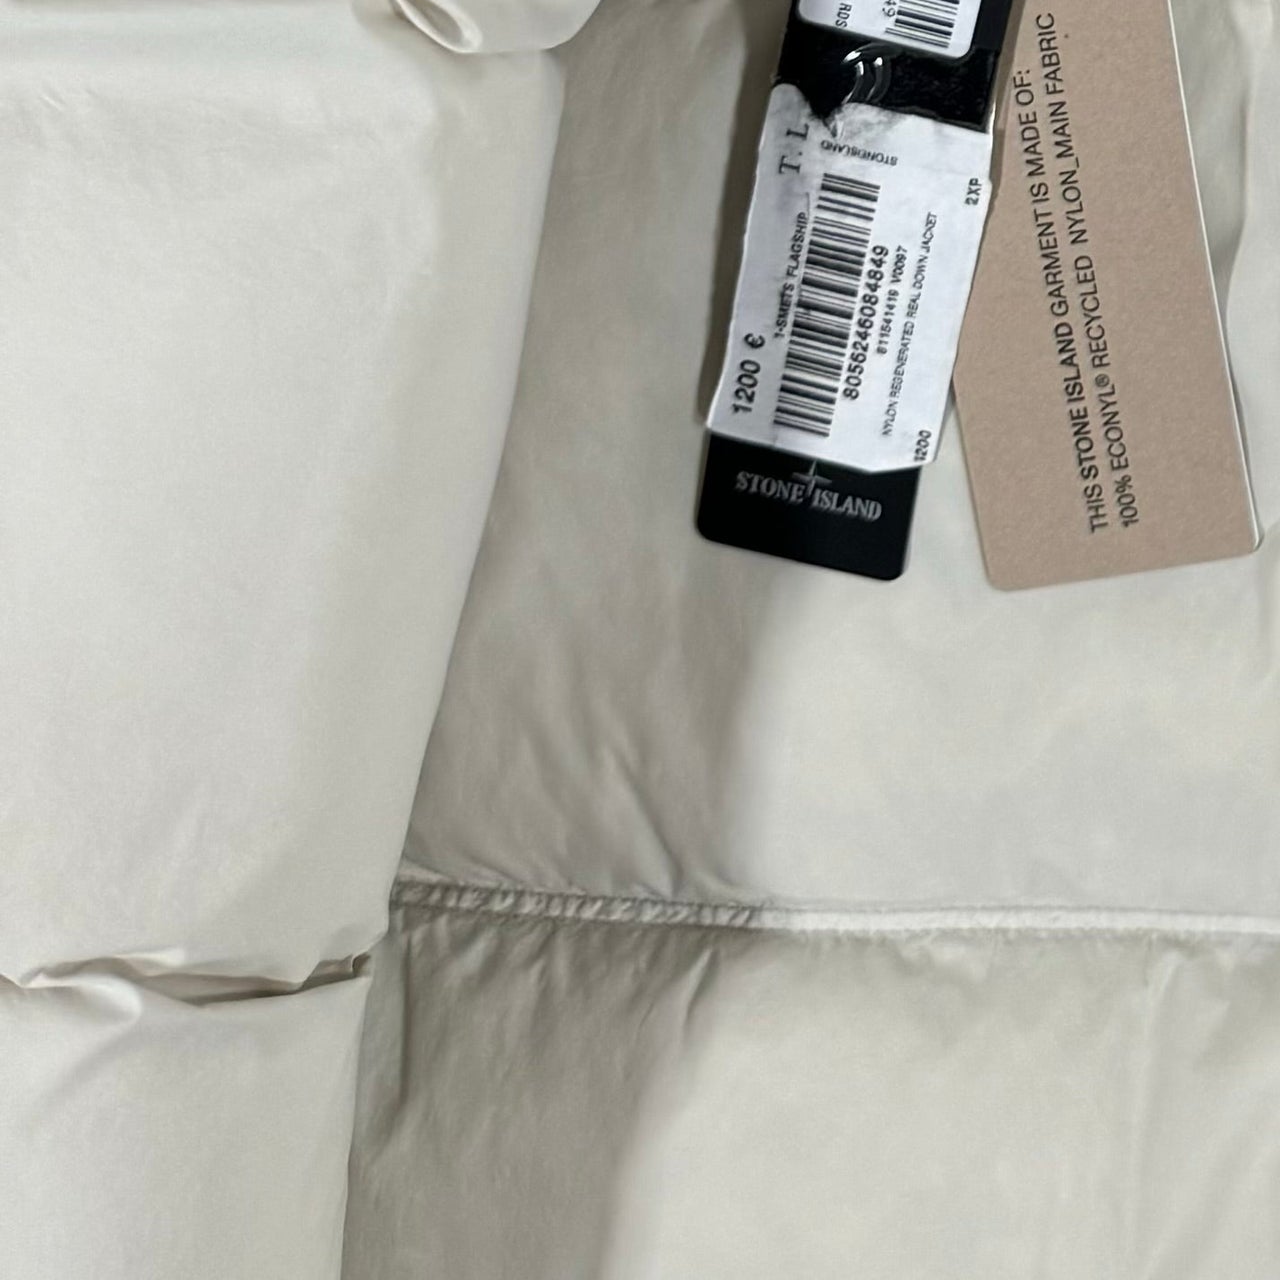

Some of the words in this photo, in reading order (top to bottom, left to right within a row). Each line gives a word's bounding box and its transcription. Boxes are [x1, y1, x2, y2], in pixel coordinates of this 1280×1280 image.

[835, 2, 852, 28] RDS
[1036, 12, 1064, 95] FABRIC
[1013, 68, 1035, 108] OF:
[1018, 111, 1046, 177] MADE
[1030, 182, 1051, 205] IS
[1047, 100, 1089, 245] NYLON_MAIN
[787, 212, 808, 278] FLAGSHIP
[920, 211, 937, 252] JACKET
[913, 250, 929, 290] DOWN
[1034, 210, 1069, 317] GARMENT
[843, 244, 889, 400] 8056246084849
[876, 289, 900, 355] 811541419
[891, 245, 908, 283] V0097
[908, 290, 922, 323] REAL
[1074, 255, 1111, 369] RECYCLED
[744, 332, 765, 349] €
[889, 323, 914, 398] REGENERATED
[1054, 322, 1086, 403] ISLAND
[732, 359, 761, 414] 1200
[882, 399, 899, 437] NYLON
[914, 429, 932, 462] 1200
[1069, 406, 1100, 480] STONE
[1094, 372, 1129, 472] ECONYL®
[735, 470, 805, 502] STONE
[810, 485, 882, 522] ISLAND
[1083, 483, 1109, 534] THIS
[1114, 474, 1140, 528] 100%
